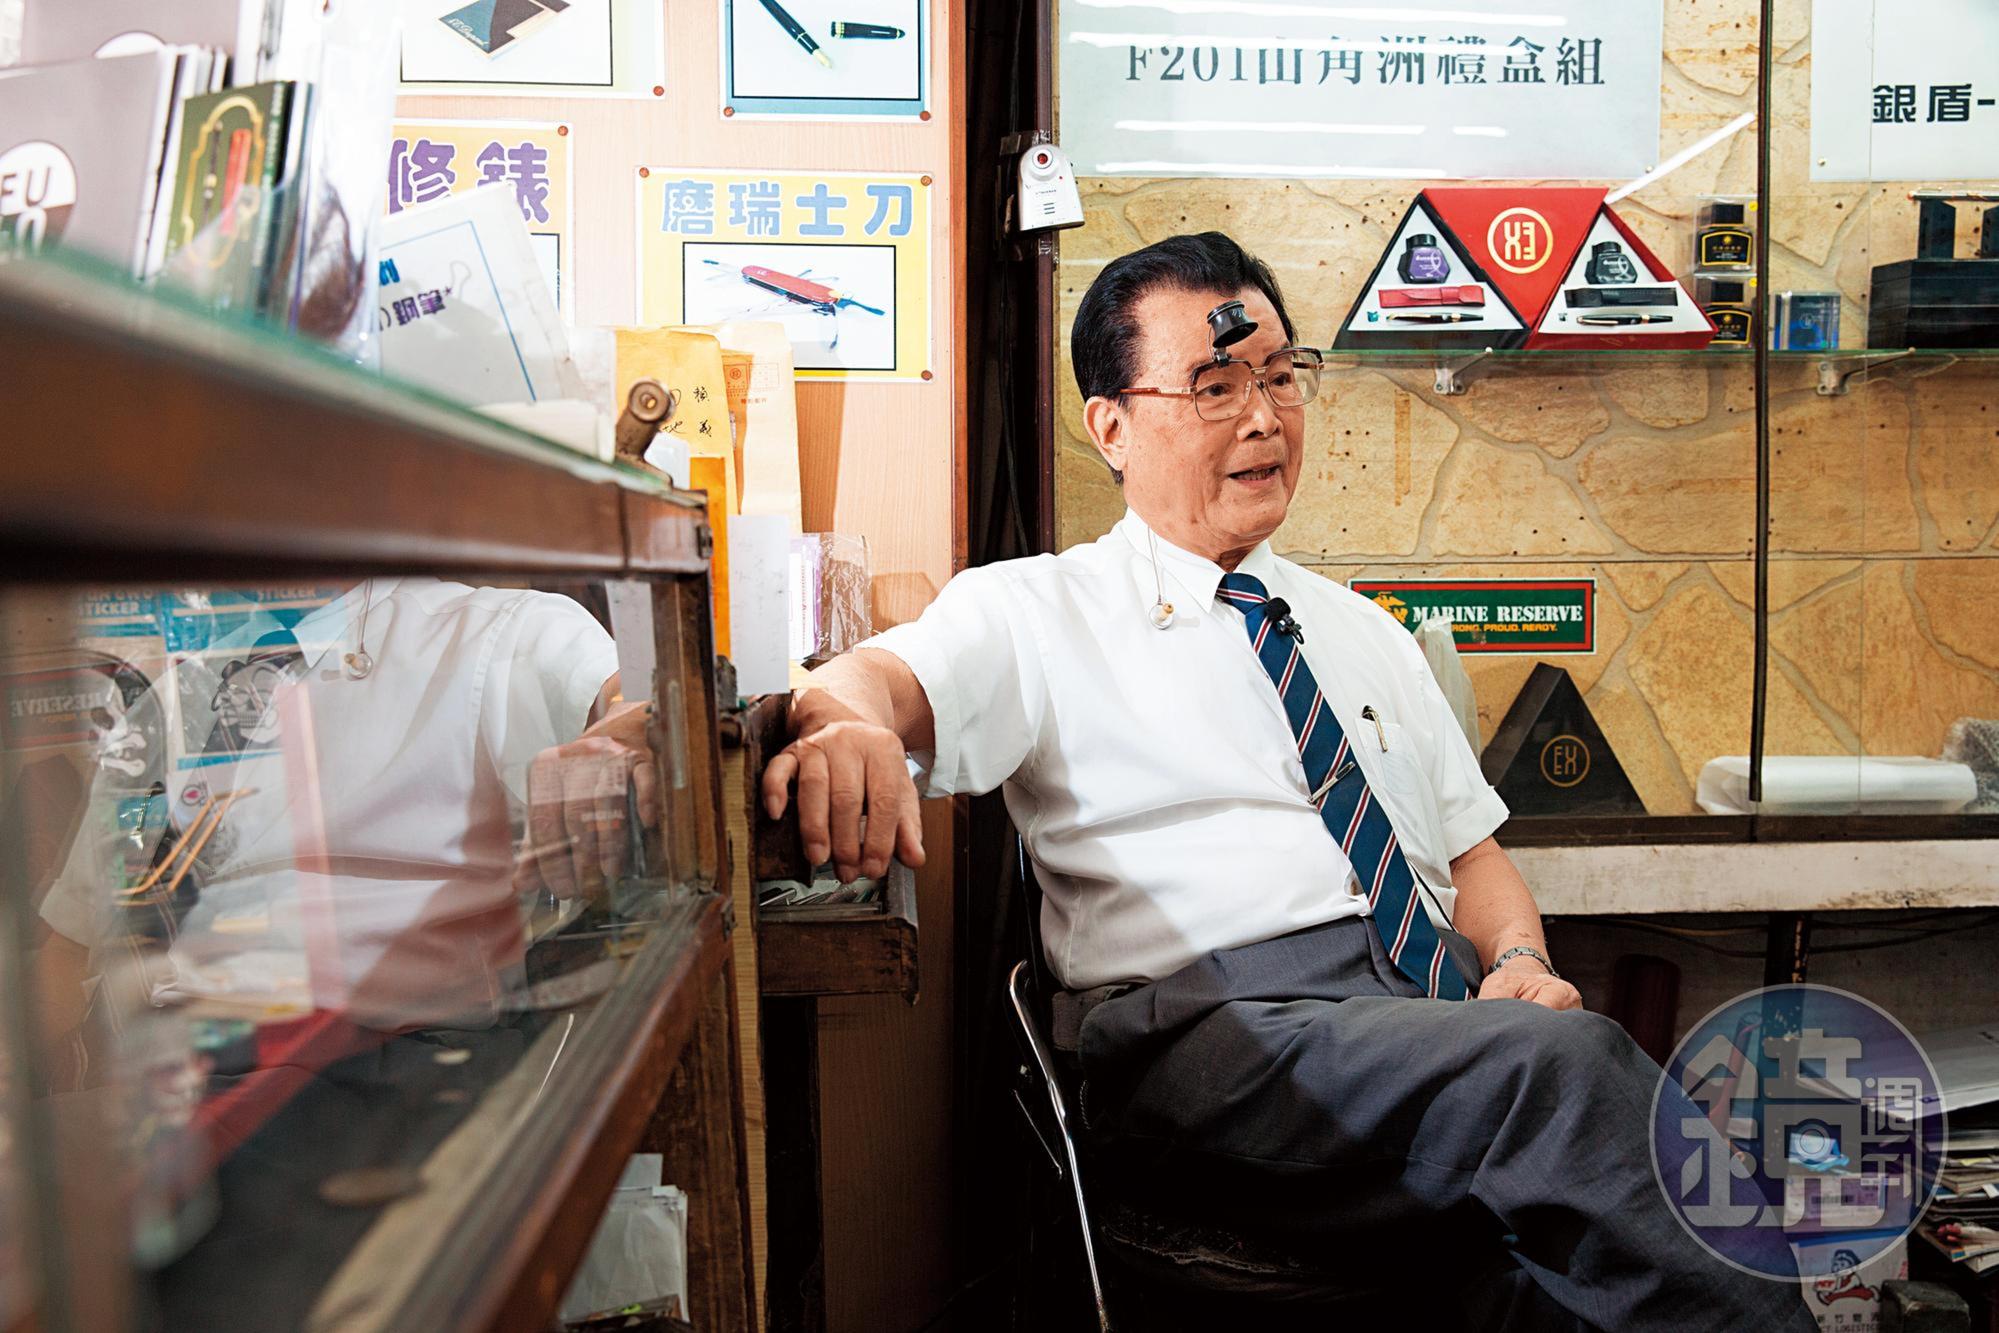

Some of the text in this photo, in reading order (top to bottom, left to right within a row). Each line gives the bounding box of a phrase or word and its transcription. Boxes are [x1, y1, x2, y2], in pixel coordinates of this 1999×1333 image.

[661, 179, 913, 237] 磨瑞士刀
[1412, 604, 1583, 623] MARINE RESERVE
[1452, 623, 1558, 632] RONG. PROUD. READY.
